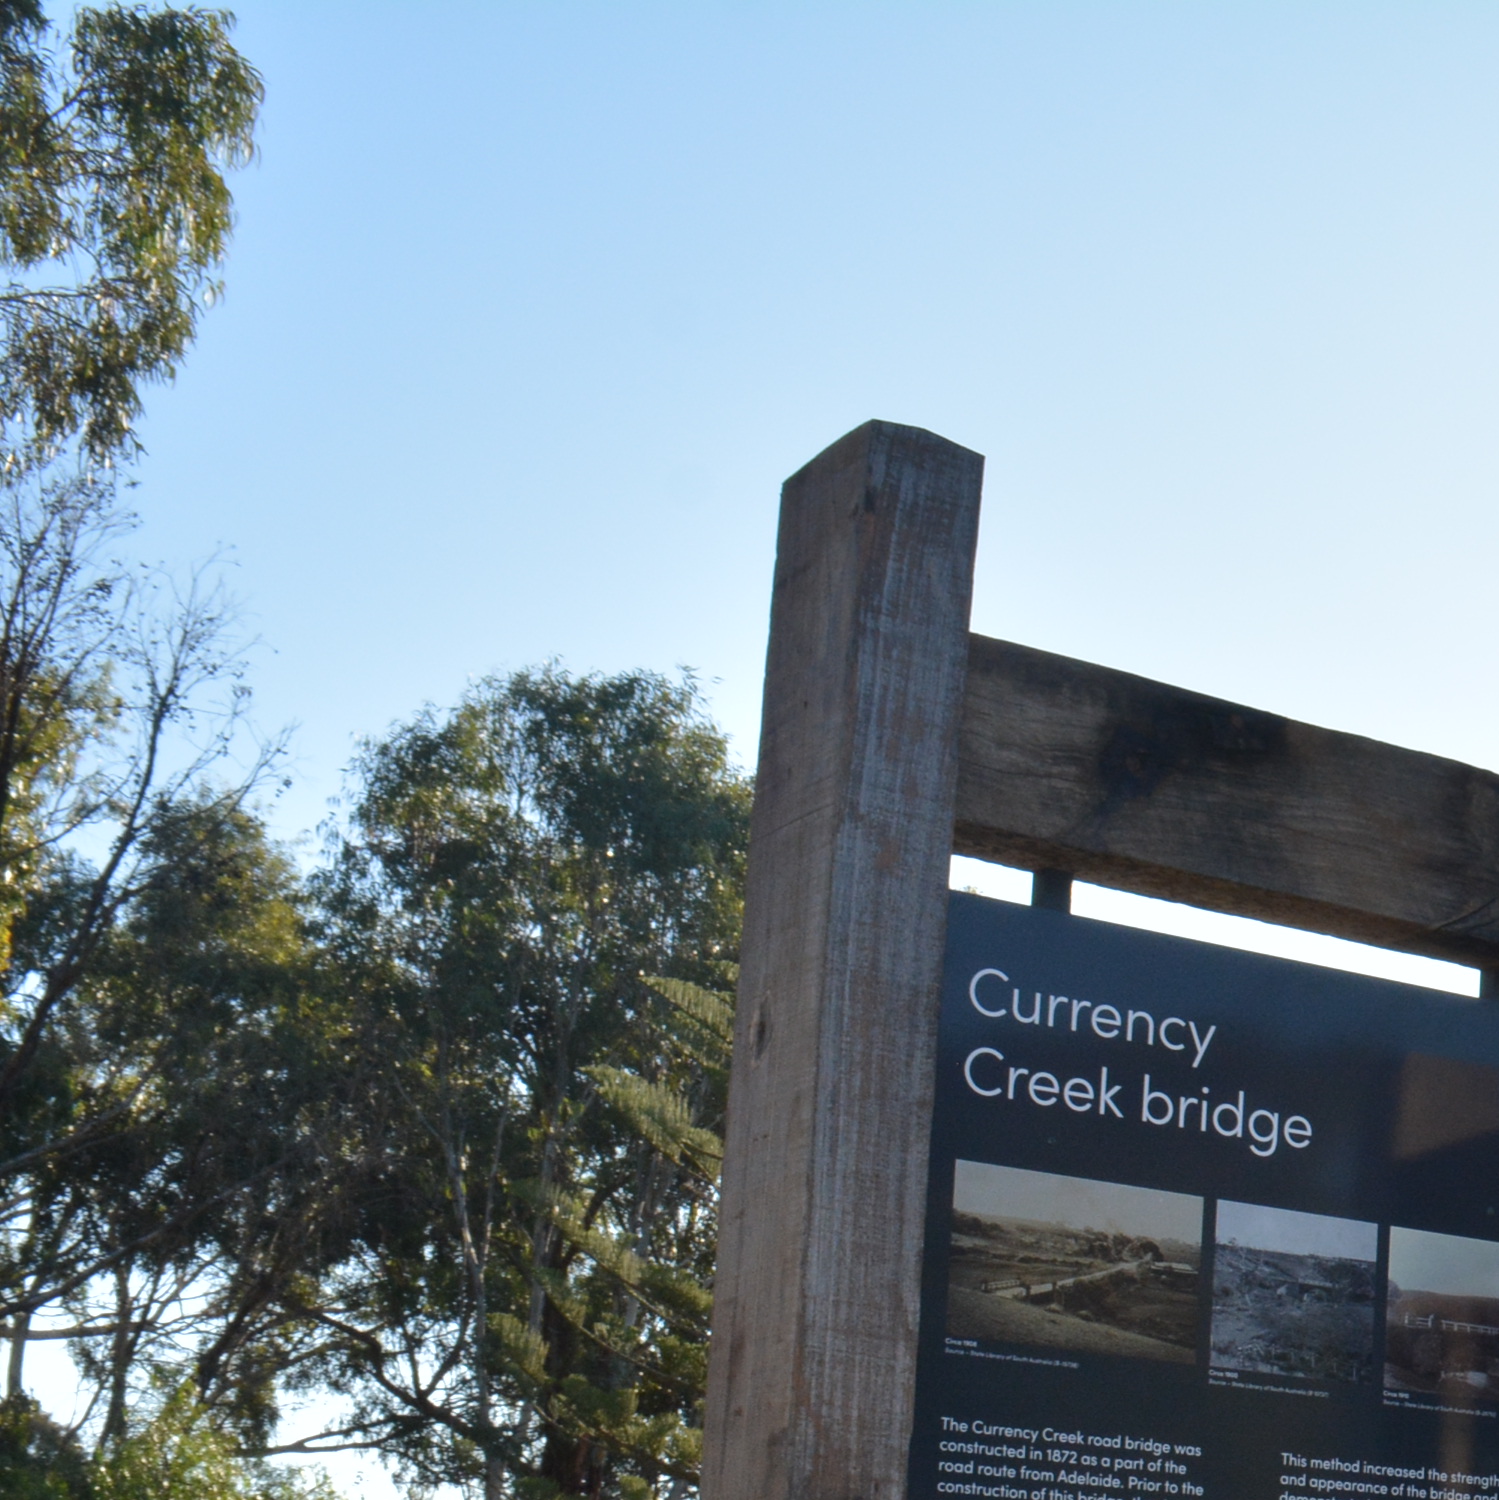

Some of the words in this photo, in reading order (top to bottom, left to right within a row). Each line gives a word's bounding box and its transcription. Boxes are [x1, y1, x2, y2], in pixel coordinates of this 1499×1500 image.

[967, 967, 1217, 1069] Currency
[963, 1047, 1125, 1120] Creek
[1140, 1074, 1314, 1158] bridge
[941, 1415, 968, 1433] The
[972, 1419, 1039, 1443] Currency
[1042, 1426, 1084, 1445] Creek
[1088, 1434, 1121, 1448] road
[1125, 1435, 1171, 1456] bridge
[1174, 1444, 1201, 1457] was
[1281, 1451, 1307, 1468] This
[1310, 1457, 1360, 1473] method
[1363, 1460, 1425, 1480] increased
[1428, 1467, 1448, 1482] the
